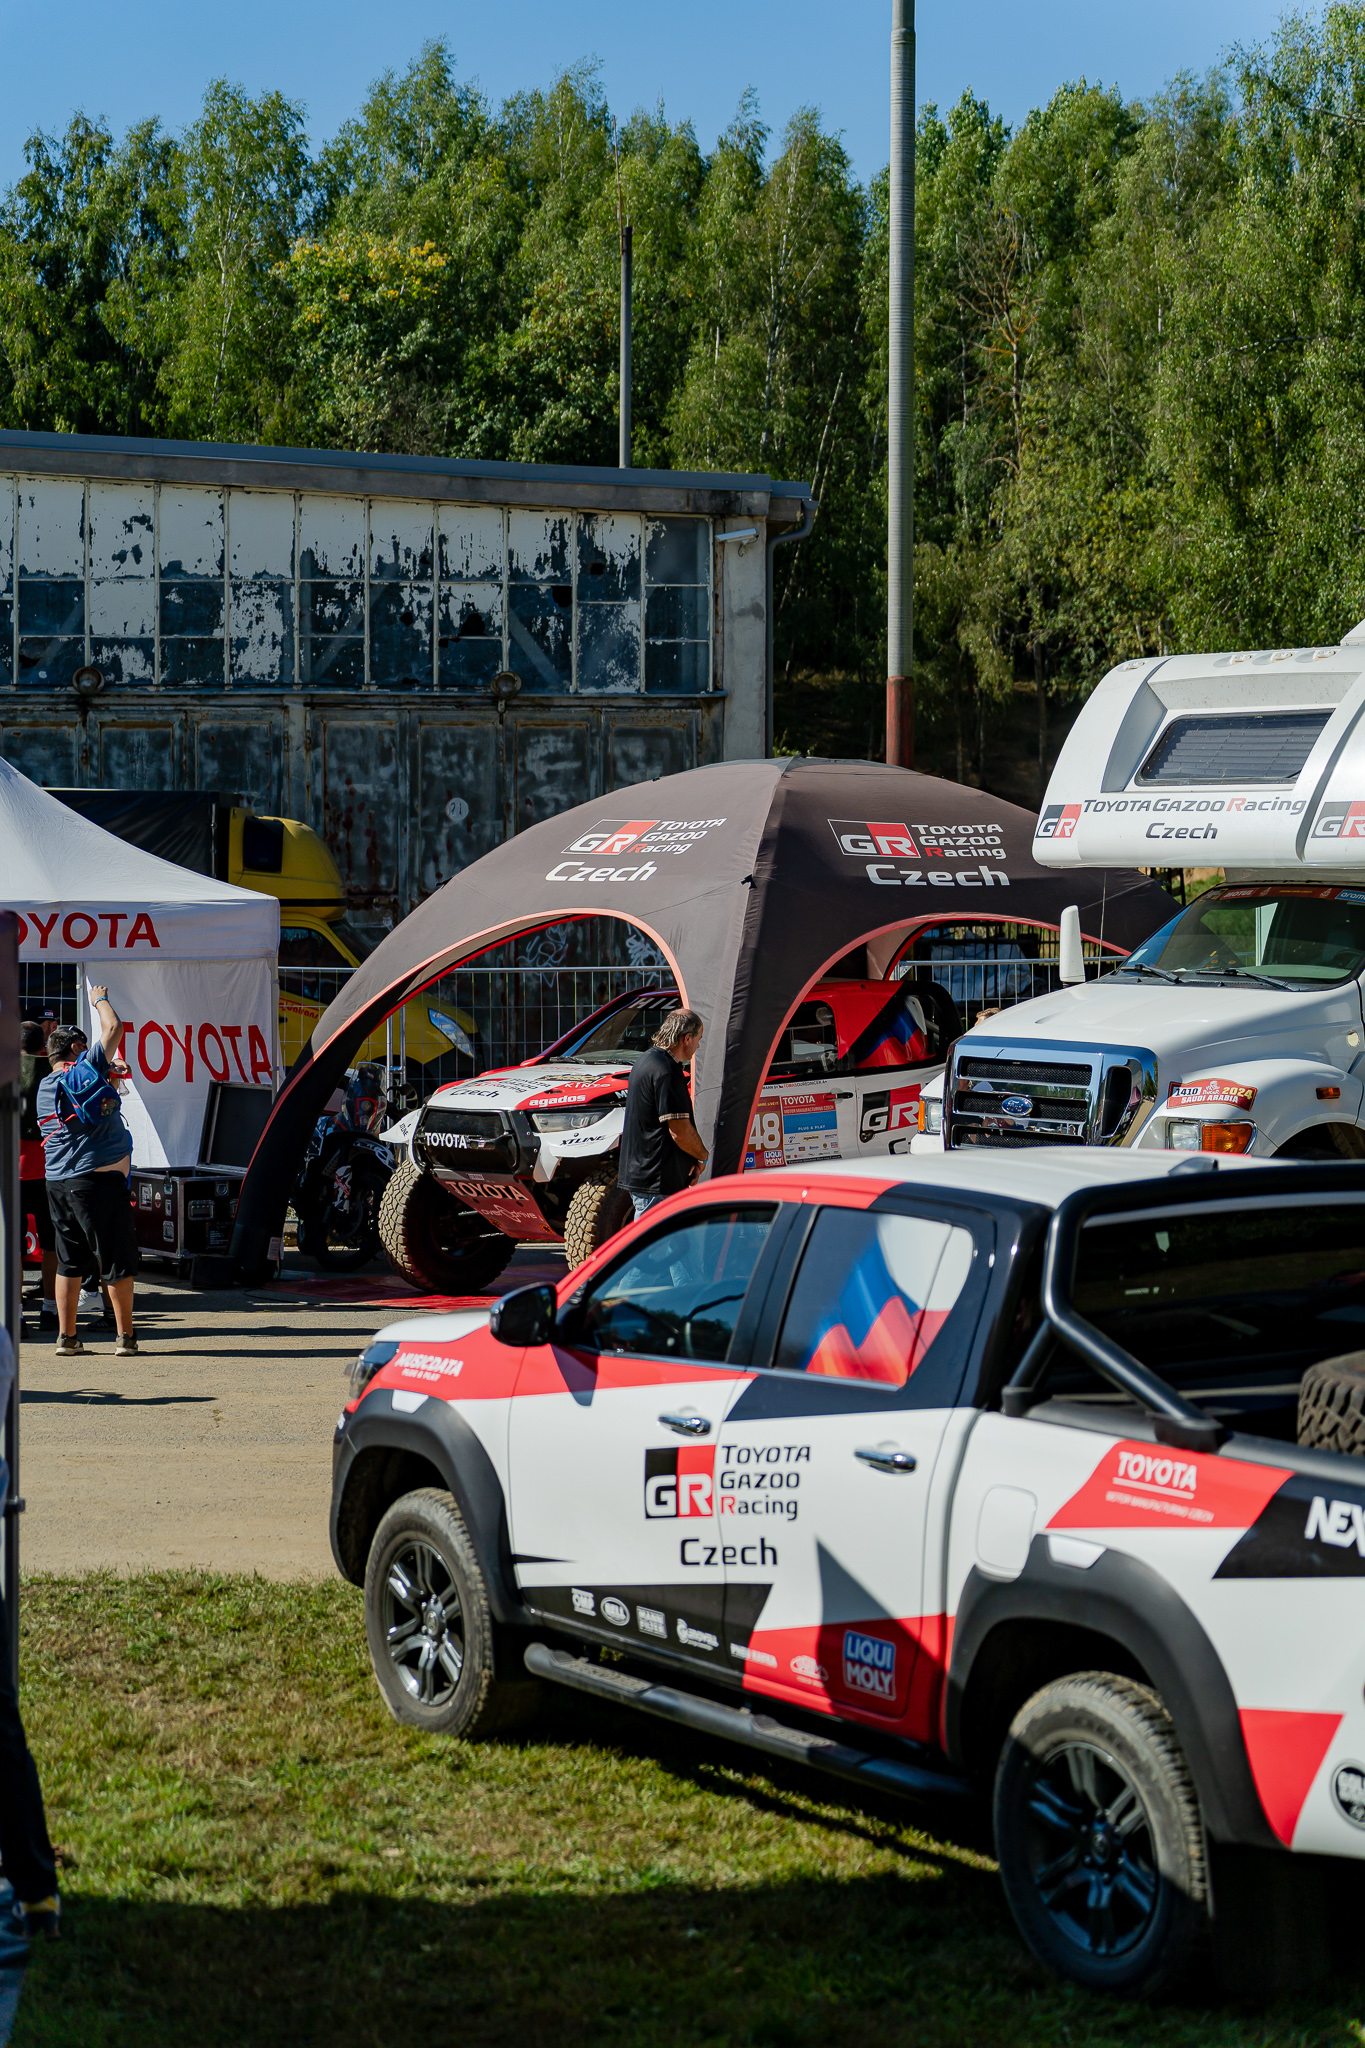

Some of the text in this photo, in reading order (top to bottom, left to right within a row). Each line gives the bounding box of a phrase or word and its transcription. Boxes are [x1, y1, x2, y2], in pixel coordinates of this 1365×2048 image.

[1083, 797, 1307, 816] TOYOTA GAZOO Racing
[656, 817, 728, 832] TOYOTA
[910, 823, 1004, 835] TOYOTA
[1037, 817, 1077, 837] GR
[1145, 822, 1219, 839] Czech
[569, 833, 638, 853] GR
[640, 830, 708, 842] GAZOO
[840, 834, 917, 857] GR
[919, 835, 1002, 847] GAZOO
[626, 842, 693, 855] Racing
[924, 846, 1008, 860] Racing
[545, 861, 658, 882] Czech
[865, 863, 1011, 887] Czech
[1340, 891, 1365, 902] aram
[18, 912, 161, 949] YOTA
[627, 997, 680, 1010] HIL
[529, 1095, 586, 1108] agados
[782, 1095, 815, 1106] TOYOTA
[1175, 1087, 1199, 1097] 1410
[1221, 1086, 1254, 1100] 2024
[1181, 1094, 1239, 1104] SAUDI ARABIA
[861, 1100, 920, 1132] GR
[425, 1132, 468, 1149] TOYOTA
[766, 1157, 784, 1165] MOLY
[445, 1181, 529, 1201] TOYOTA
[394, 1352, 464, 1377] MUSICDATA
[721, 1445, 812, 1464] TOYOTA
[720, 1470, 801, 1489] GAZOO
[1118, 1451, 1198, 1491] TOYOTA
[645, 1473, 713, 1517] GR
[720, 1494, 799, 1521] Racing
[680, 1537, 778, 1566] Czech
[845, 1636, 892, 1669] LIQUI
[846, 1661, 894, 1694] MOLY
